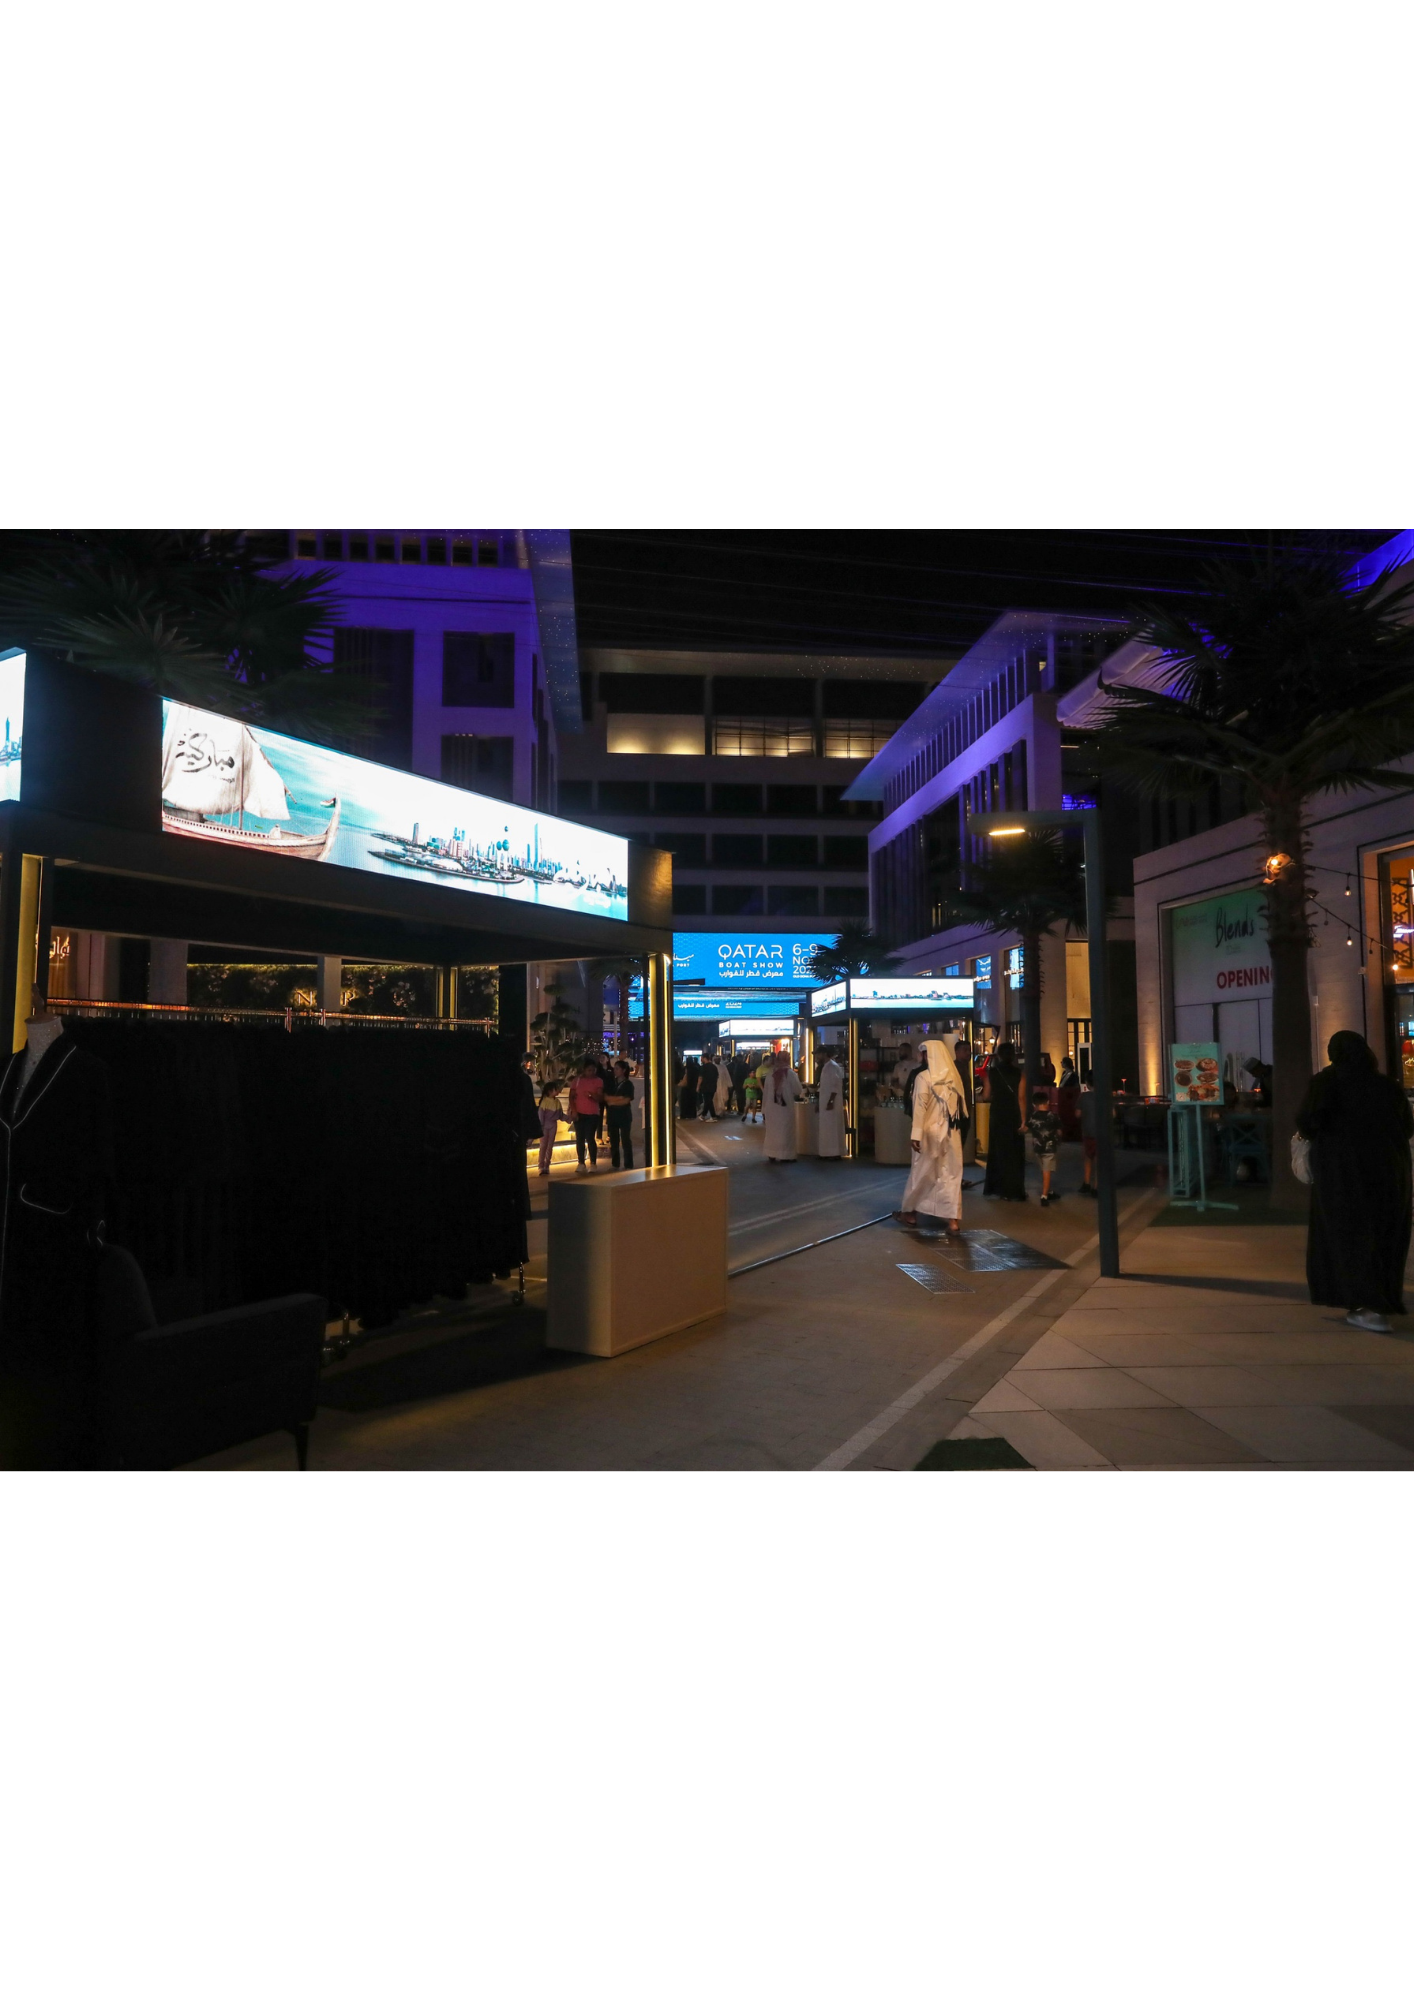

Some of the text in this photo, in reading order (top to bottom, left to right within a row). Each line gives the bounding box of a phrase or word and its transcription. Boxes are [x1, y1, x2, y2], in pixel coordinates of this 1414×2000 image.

[1215, 903, 1254, 948] Blends
[718, 944, 784, 960] QATAR
[792, 956, 811, 965] NO
[718, 969, 784, 978] معرض قطر للقوارب
[792, 965, 814, 974] 202
[1216, 966, 1273, 989] OPENIN
